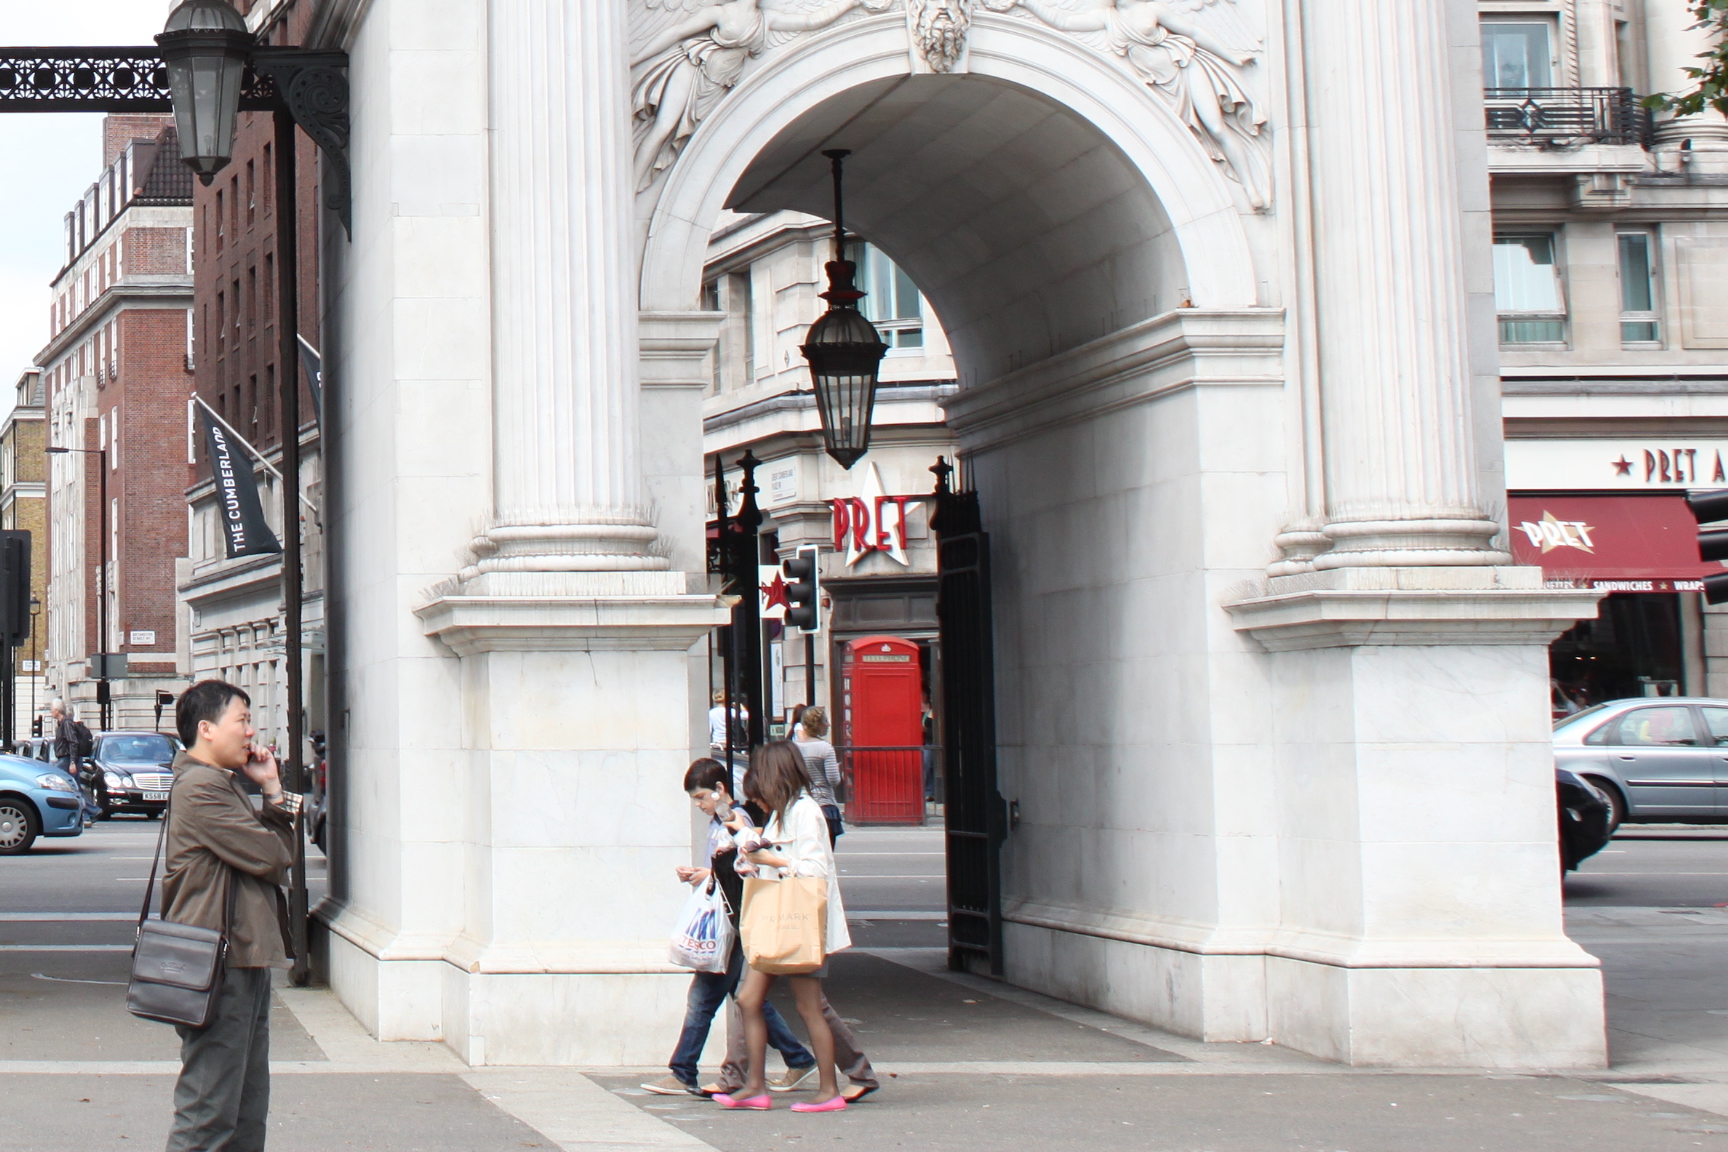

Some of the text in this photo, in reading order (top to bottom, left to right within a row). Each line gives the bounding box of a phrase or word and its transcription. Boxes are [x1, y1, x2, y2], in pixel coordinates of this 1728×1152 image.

[1643, 448, 1726, 483] PRET A
[212, 426, 246, 553] THE CUMBERLAND
[833, 496, 909, 552] PRET
[1521, 520, 1594, 547] PRET
[1593, 580, 1653, 591] SANDWICHES
[761, 912, 810, 924] PRMARK
[682, 934, 717, 951] TESCO
